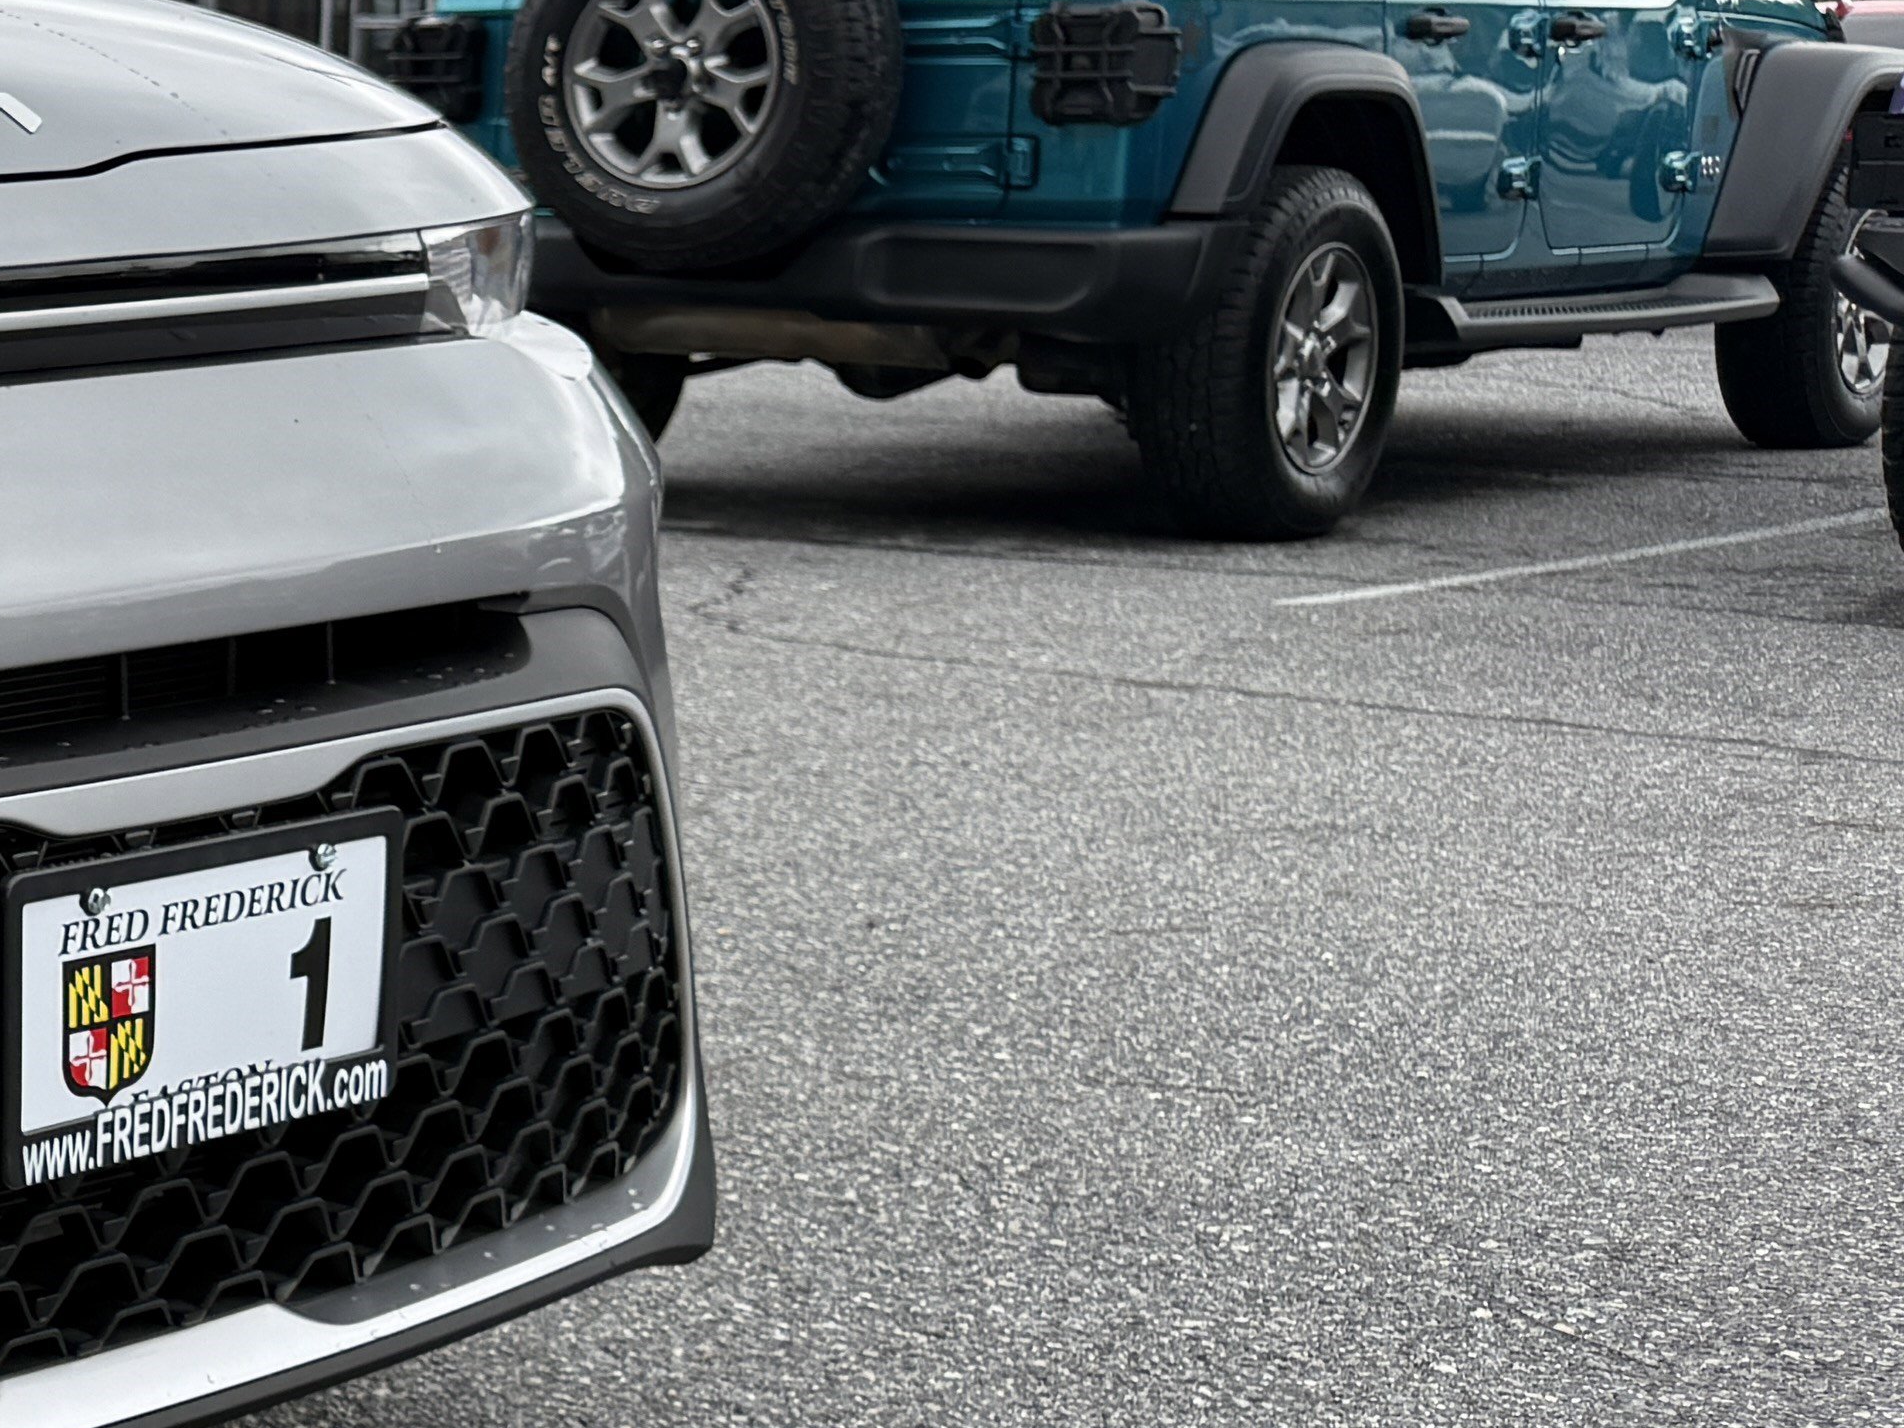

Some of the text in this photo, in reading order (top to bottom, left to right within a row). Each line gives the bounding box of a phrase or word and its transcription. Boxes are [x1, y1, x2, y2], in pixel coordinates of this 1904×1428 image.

[60, 870, 346, 956] FRED FREDERICK
[290, 916, 333, 1052] 1
[23, 1058, 388, 1186] www.FREDFREDERICK.com
